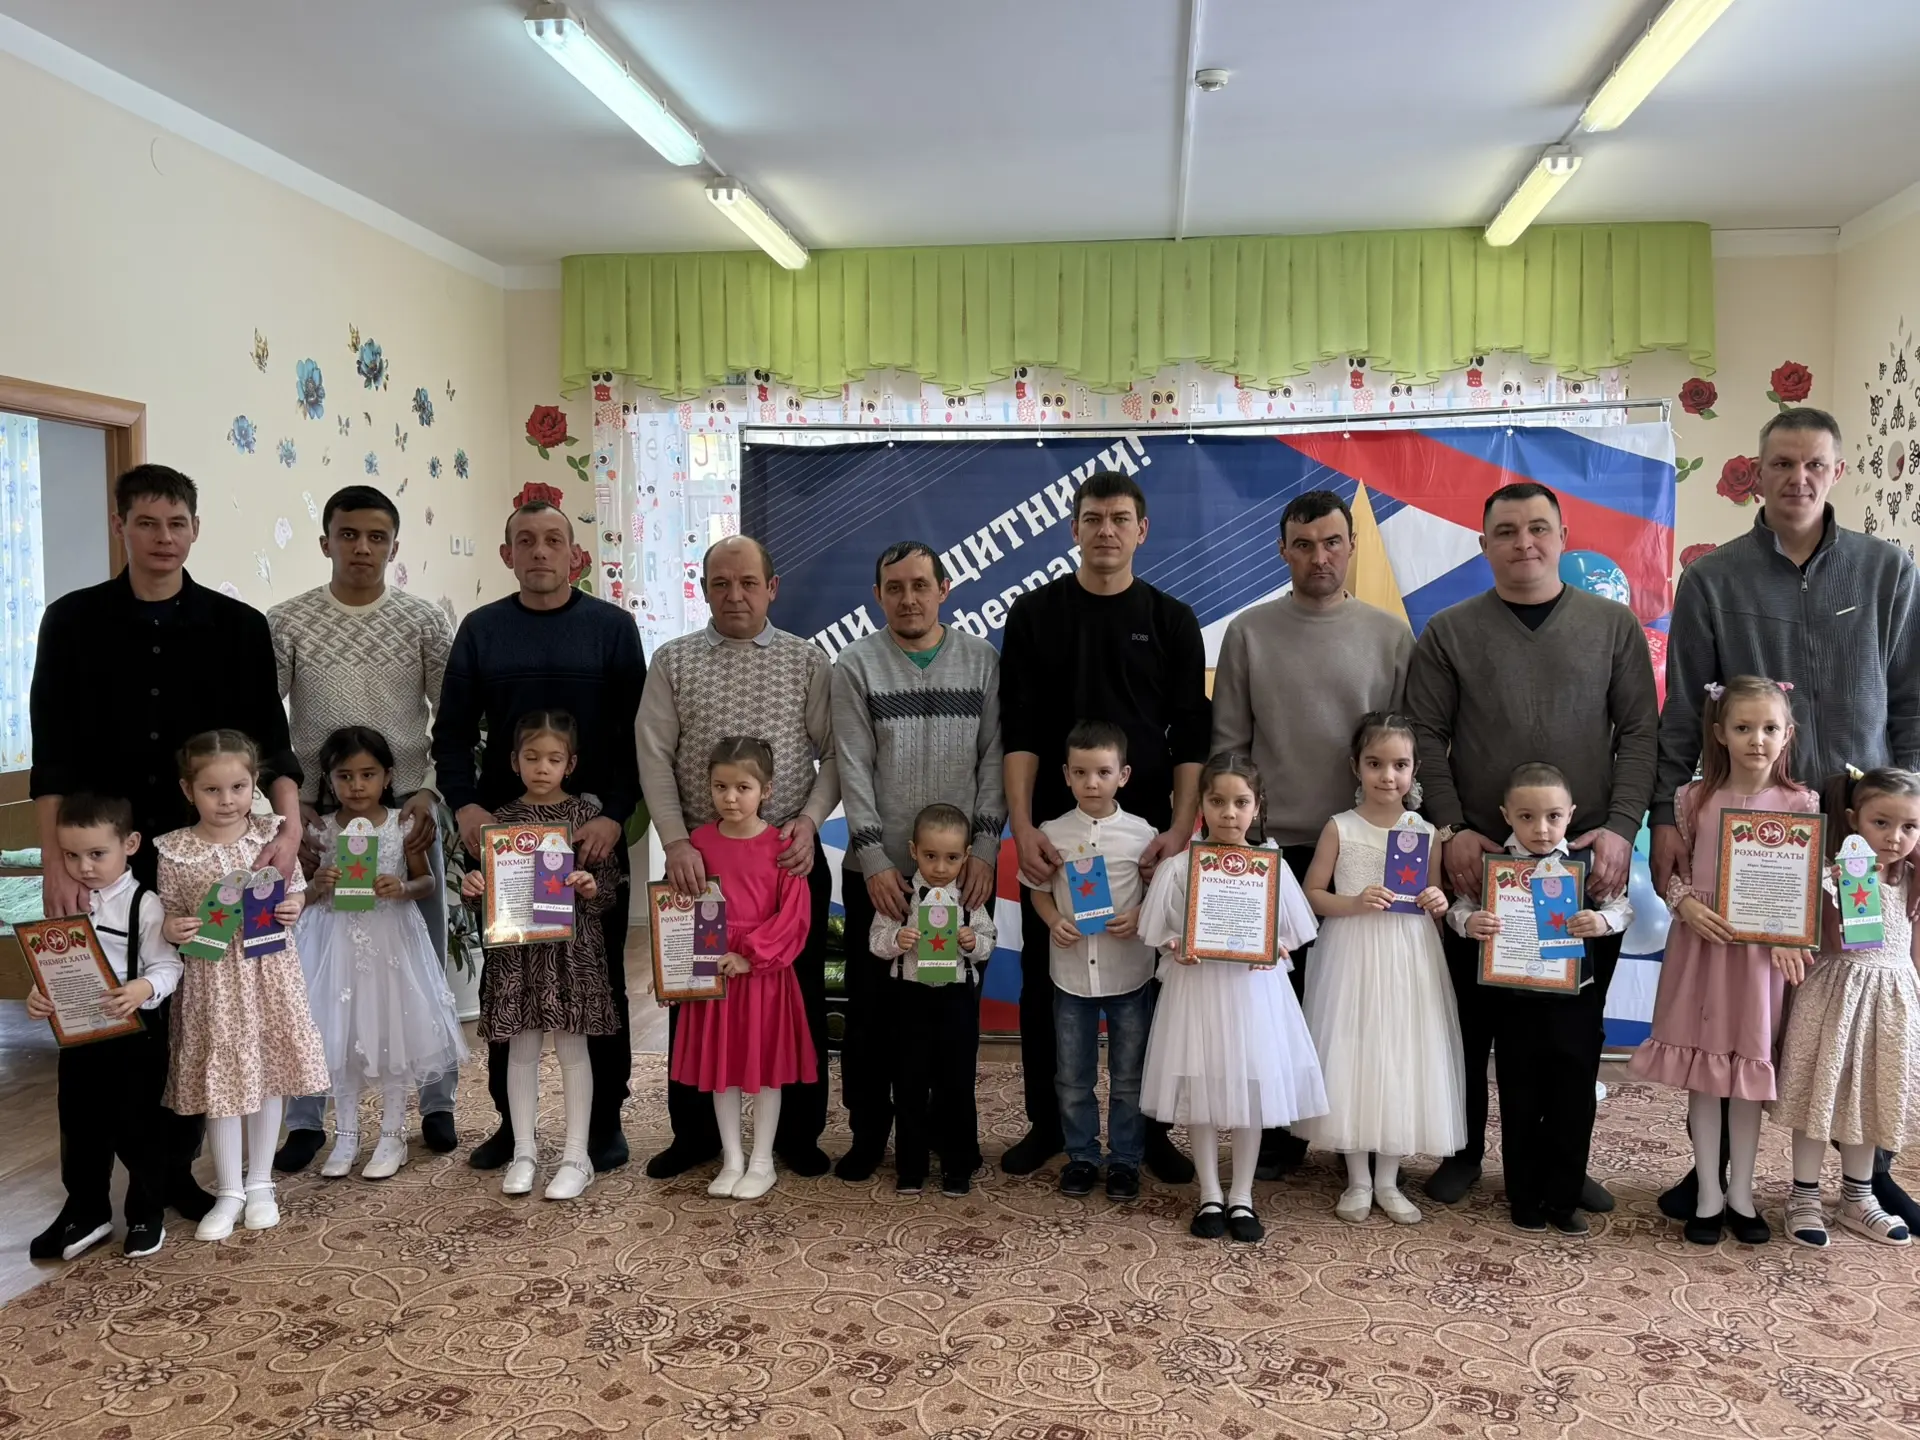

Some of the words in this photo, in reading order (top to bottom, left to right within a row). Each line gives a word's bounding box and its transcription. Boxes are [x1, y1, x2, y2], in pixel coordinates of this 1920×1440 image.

[807, 604, 879, 665] ШИ
[939, 436, 1151, 591] ЩИТНИИ!
[1131, 633, 1149, 642] BOSS
[1776, 852, 1804, 860] ХАТЫ
[1239, 878, 1264, 888] ХАТЫ
[1499, 894, 1532, 903] РӘХМӘ
